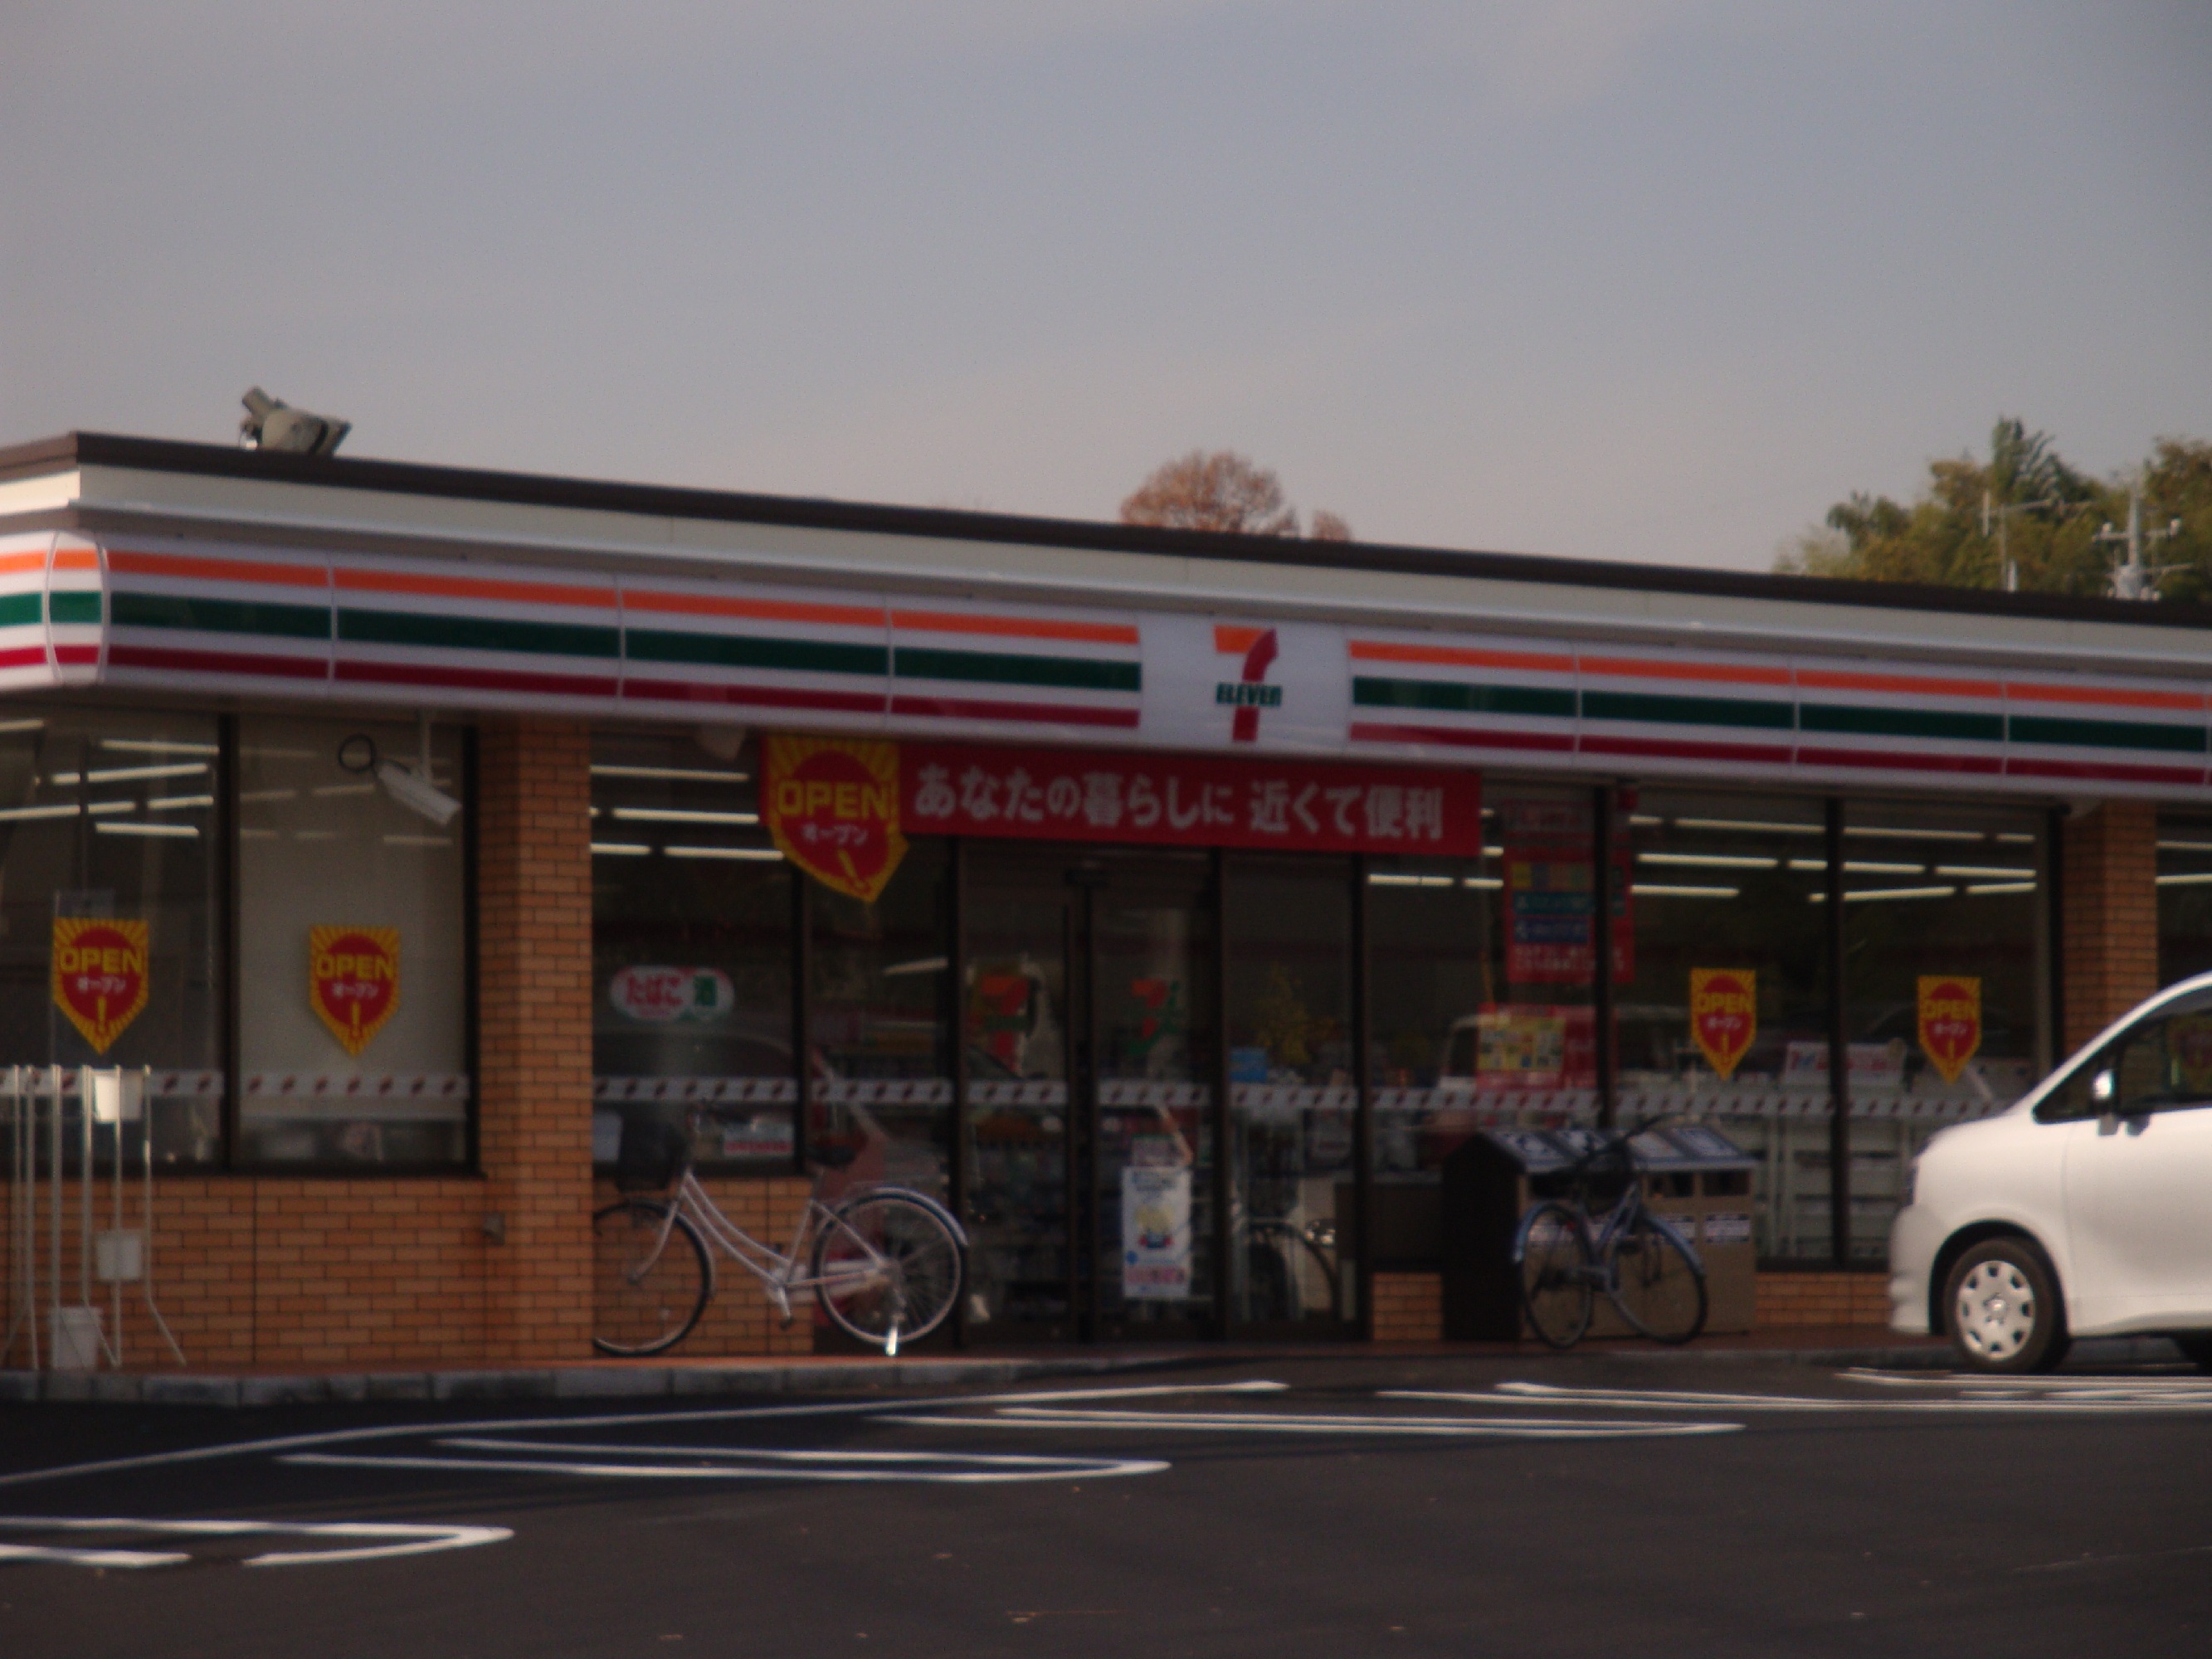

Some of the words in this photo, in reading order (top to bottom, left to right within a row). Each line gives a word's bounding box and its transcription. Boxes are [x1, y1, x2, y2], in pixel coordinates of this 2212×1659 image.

[778, 781, 889, 819] OPEN
[914, 763, 1235, 830] あなたの暮らしに
[1249, 777, 1445, 841] 近くて便利
[801, 822, 869, 846] オープン
[59, 947, 144, 973] OPEN
[316, 954, 394, 979] OPEN
[1694, 992, 1753, 1014] OPEN
[1922, 1000, 1978, 1021] OPEN
